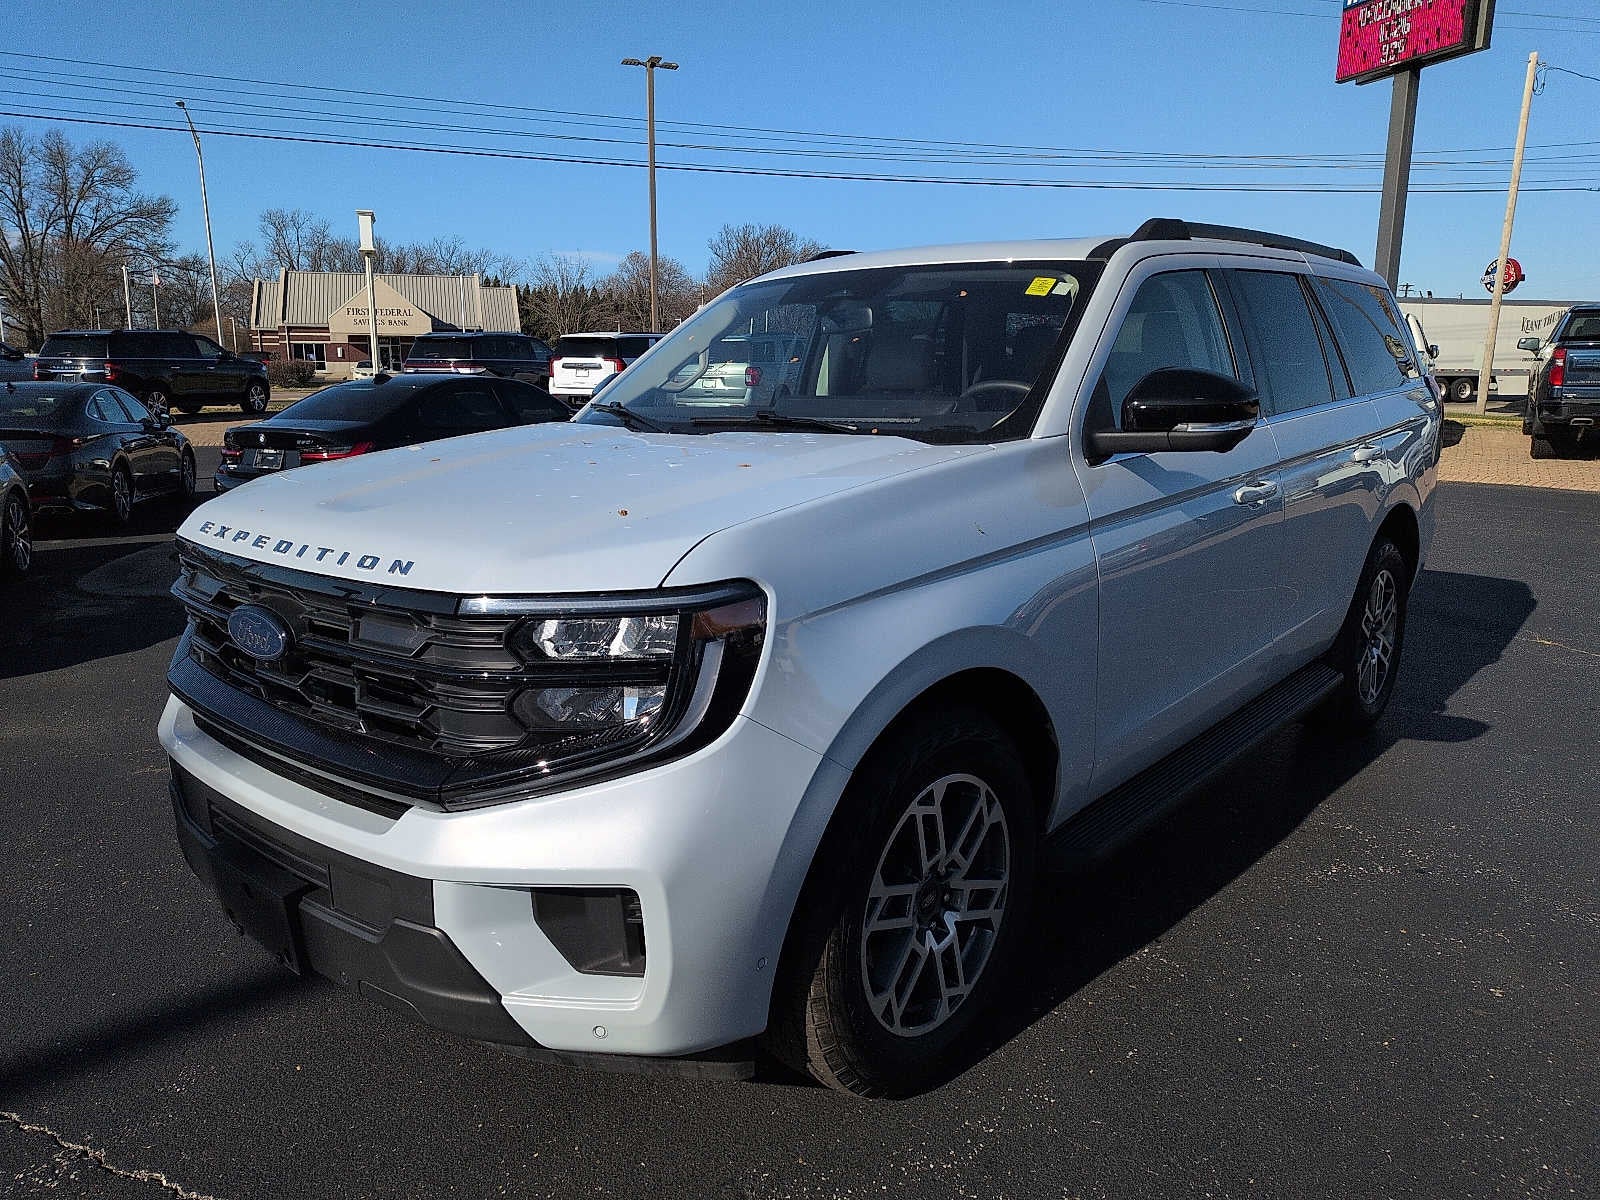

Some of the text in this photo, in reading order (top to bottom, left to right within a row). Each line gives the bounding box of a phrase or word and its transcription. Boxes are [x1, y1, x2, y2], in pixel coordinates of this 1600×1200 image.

[346, 307, 413, 317] FIRST FEDERAL
[353, 318, 409, 327] SAVIGS BANK
[199, 520, 415, 576] EXPEDITION
